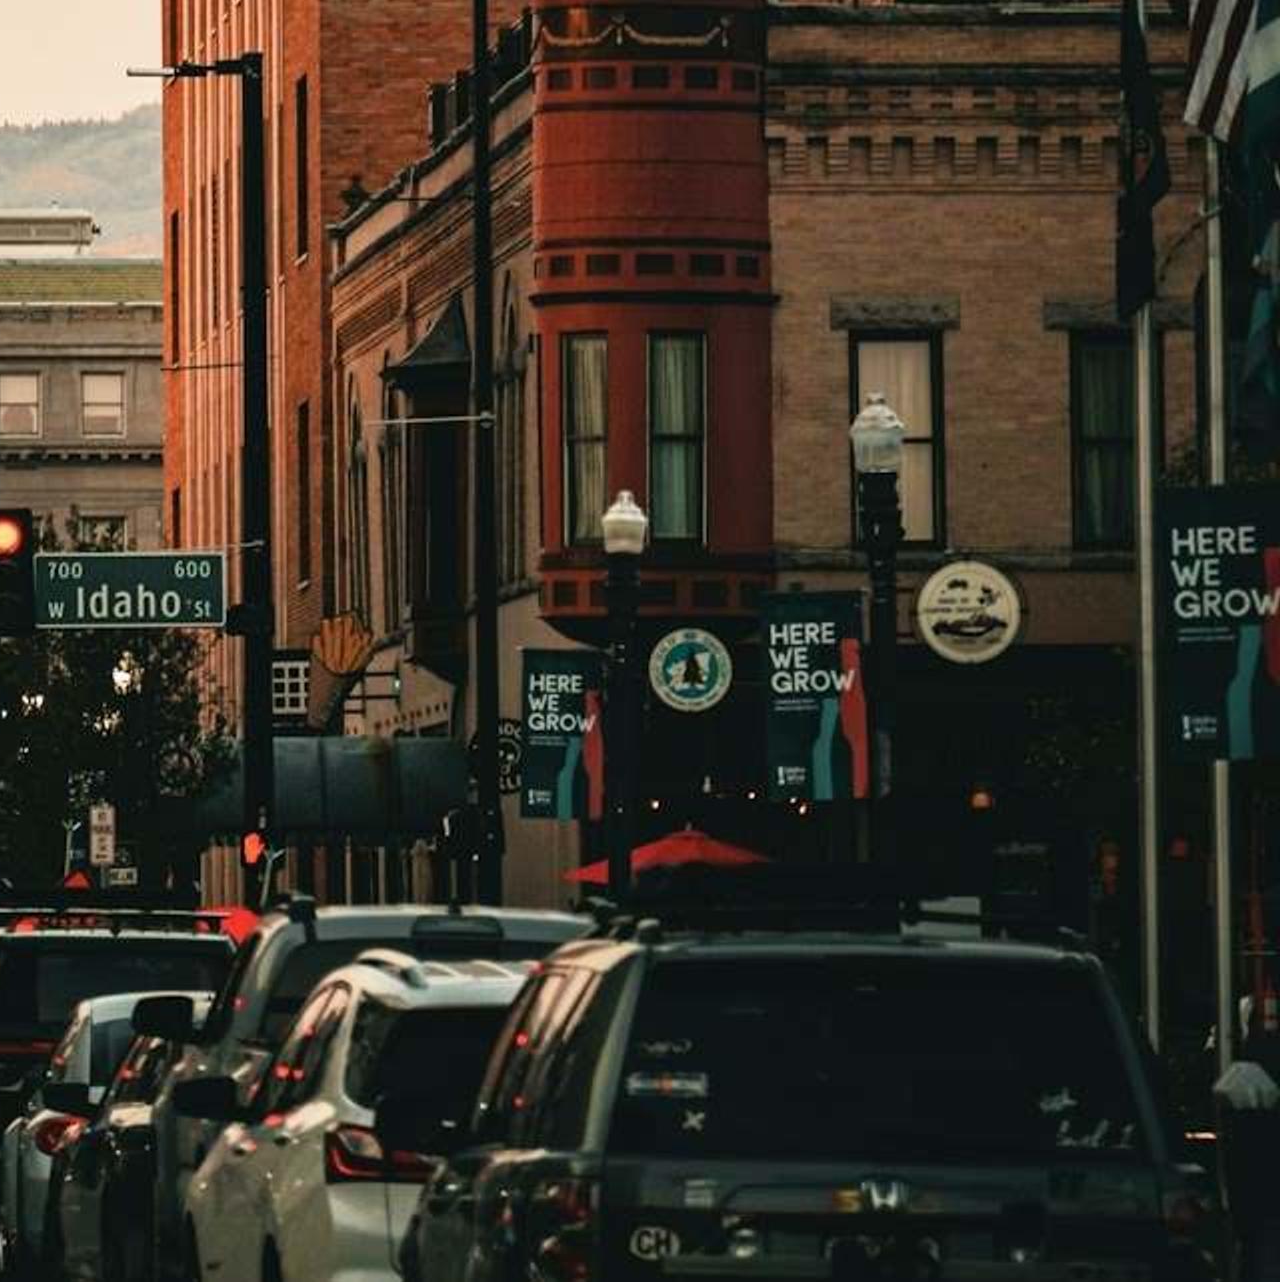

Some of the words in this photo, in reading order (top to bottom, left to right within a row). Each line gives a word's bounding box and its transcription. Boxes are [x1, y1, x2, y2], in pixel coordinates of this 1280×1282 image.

[1171, 526, 1256, 555] HERE
[47, 560, 83, 581] 700
[174, 559, 211, 578] 600
[1172, 559, 1220, 587] WE
[49, 602, 64, 618] W
[76, 584, 183, 619] Idaho
[194, 599, 211, 618] St
[1173, 589, 1280, 618] GROW
[770, 622, 836, 646] HERE
[770, 647, 809, 670] WE
[529, 674, 583, 694] HERE
[771, 670, 856, 694] GROW
[529, 694, 559, 714] WE
[528, 713, 596, 733] GROW
[637, 1231, 671, 1253] CH
